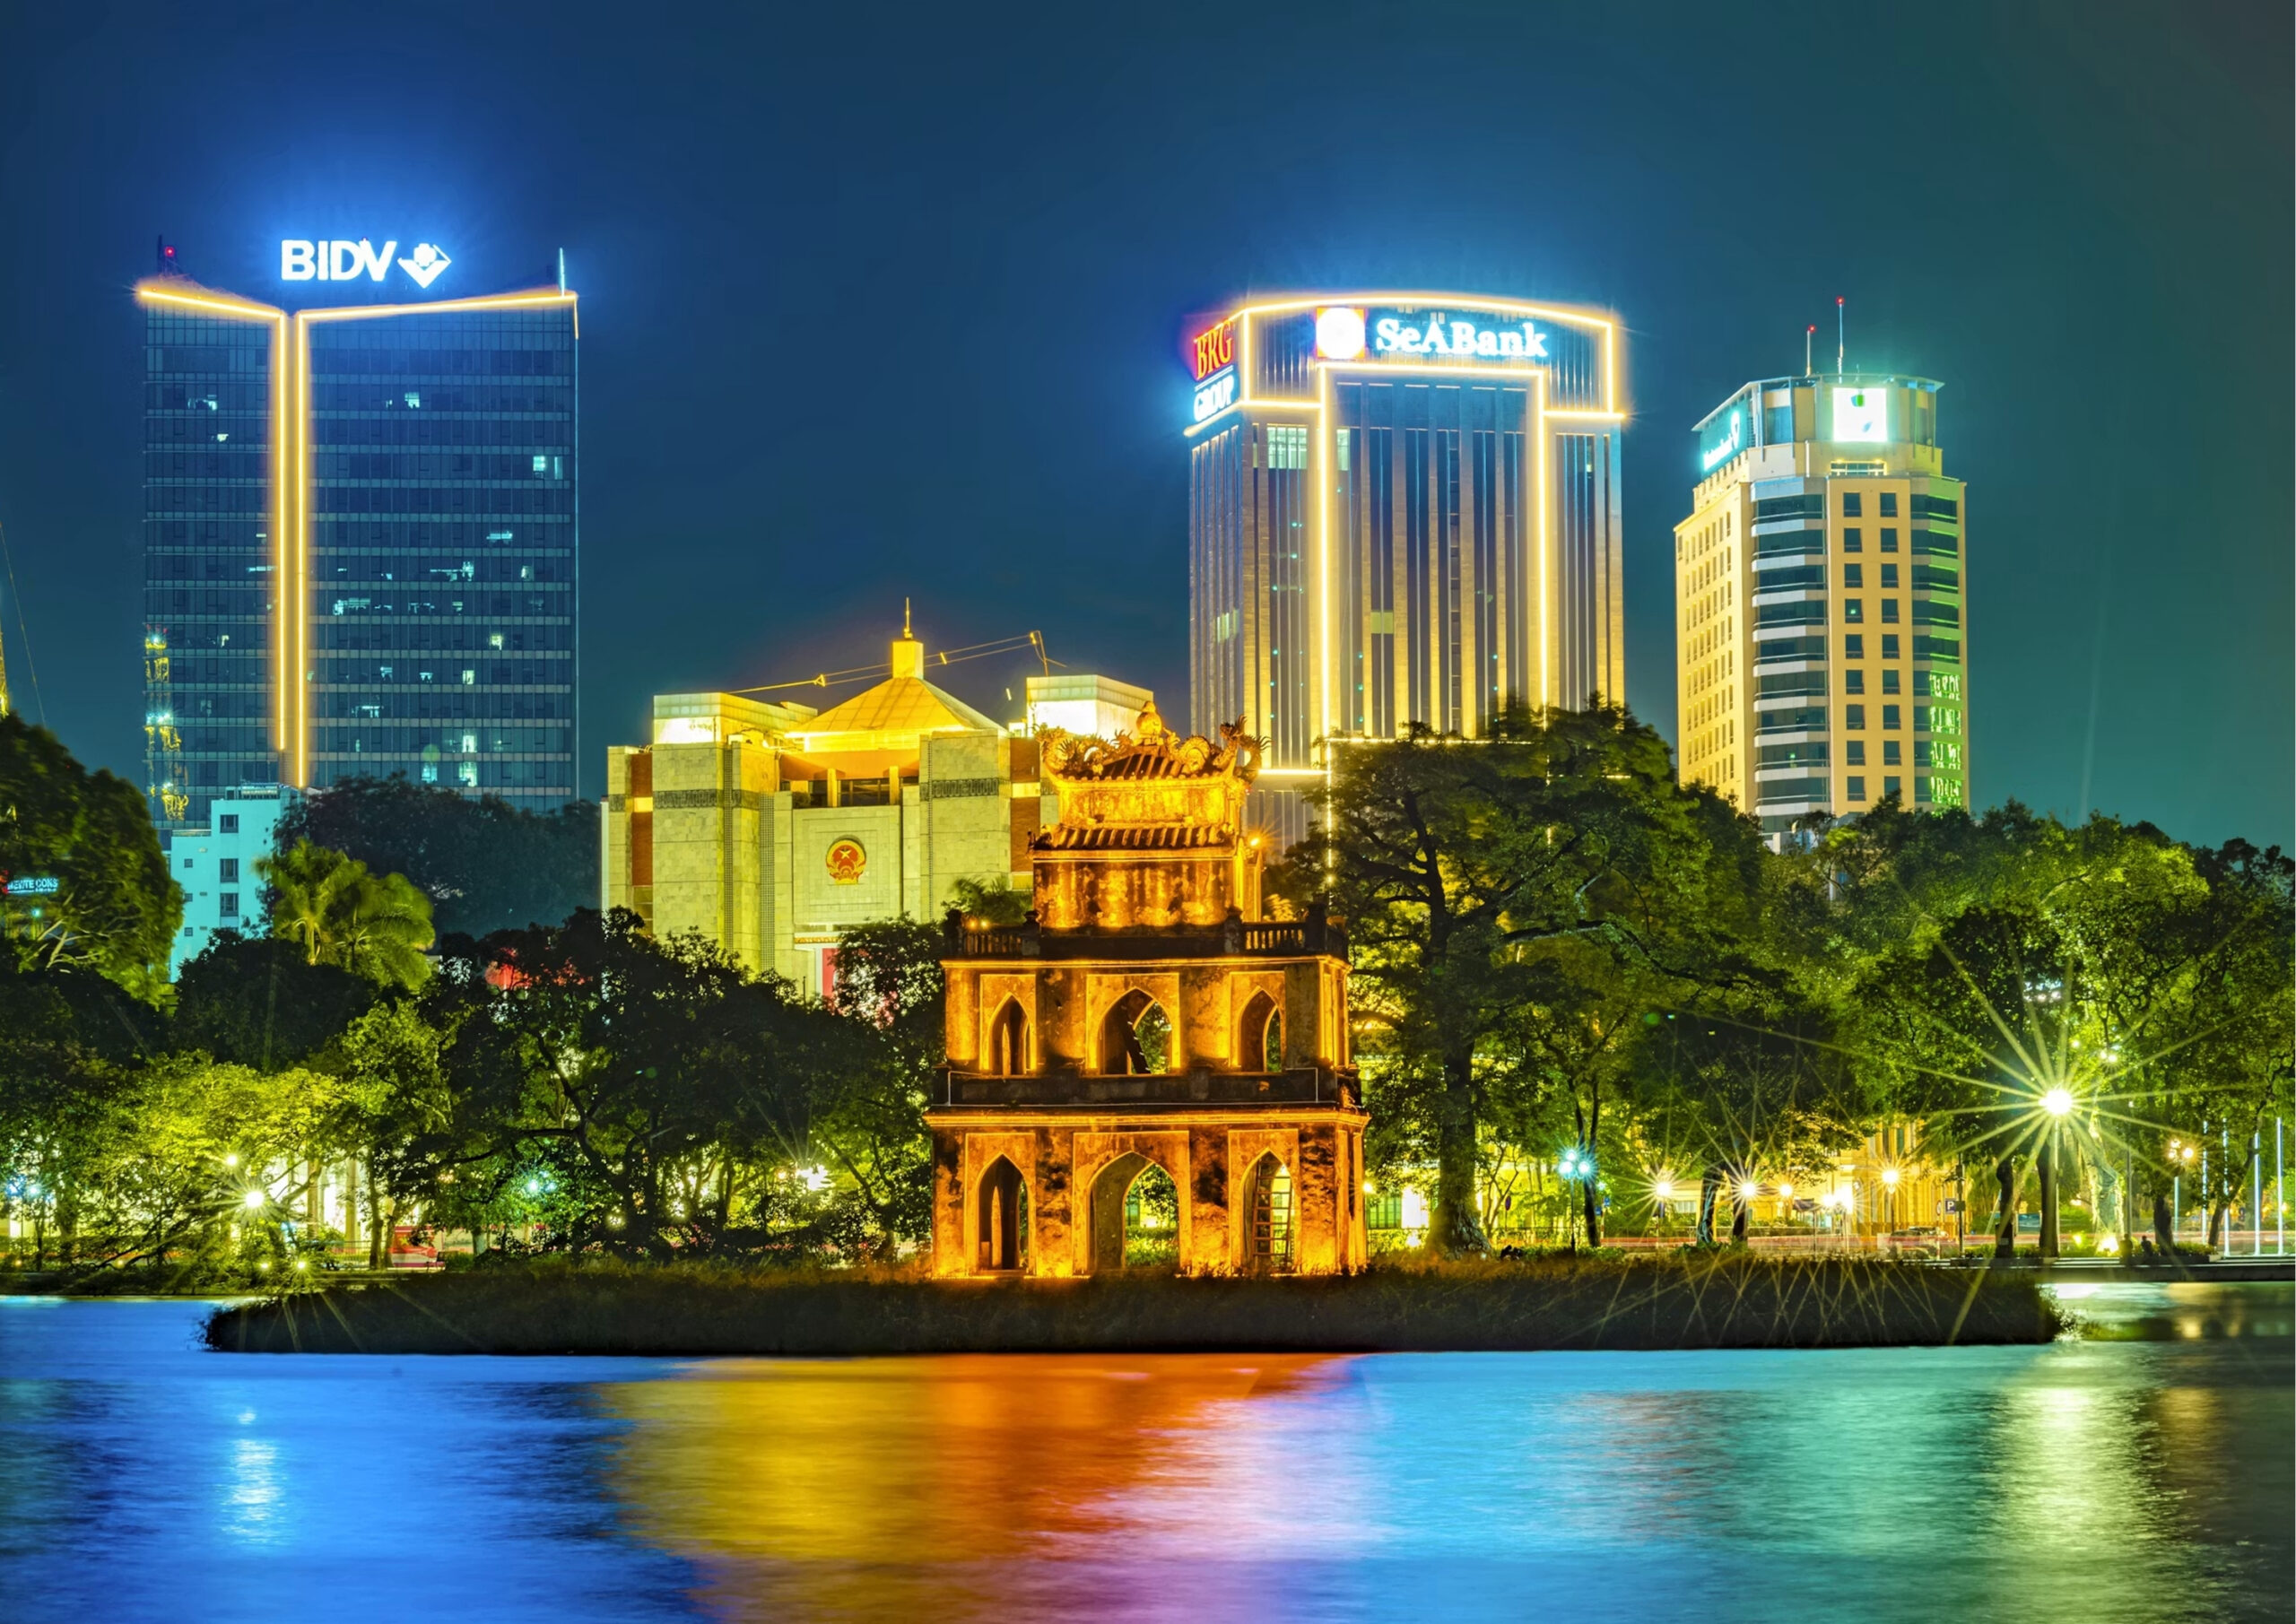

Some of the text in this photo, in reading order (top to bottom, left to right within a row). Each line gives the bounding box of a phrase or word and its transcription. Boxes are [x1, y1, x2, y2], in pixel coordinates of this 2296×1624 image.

[281, 239, 397, 281] BIDV
[1196, 320, 1232, 380] BRG
[1376, 318, 1548, 357] SeABank
[1194, 375, 1234, 422] GROUP
[1947, 1201, 1955, 1211] P
